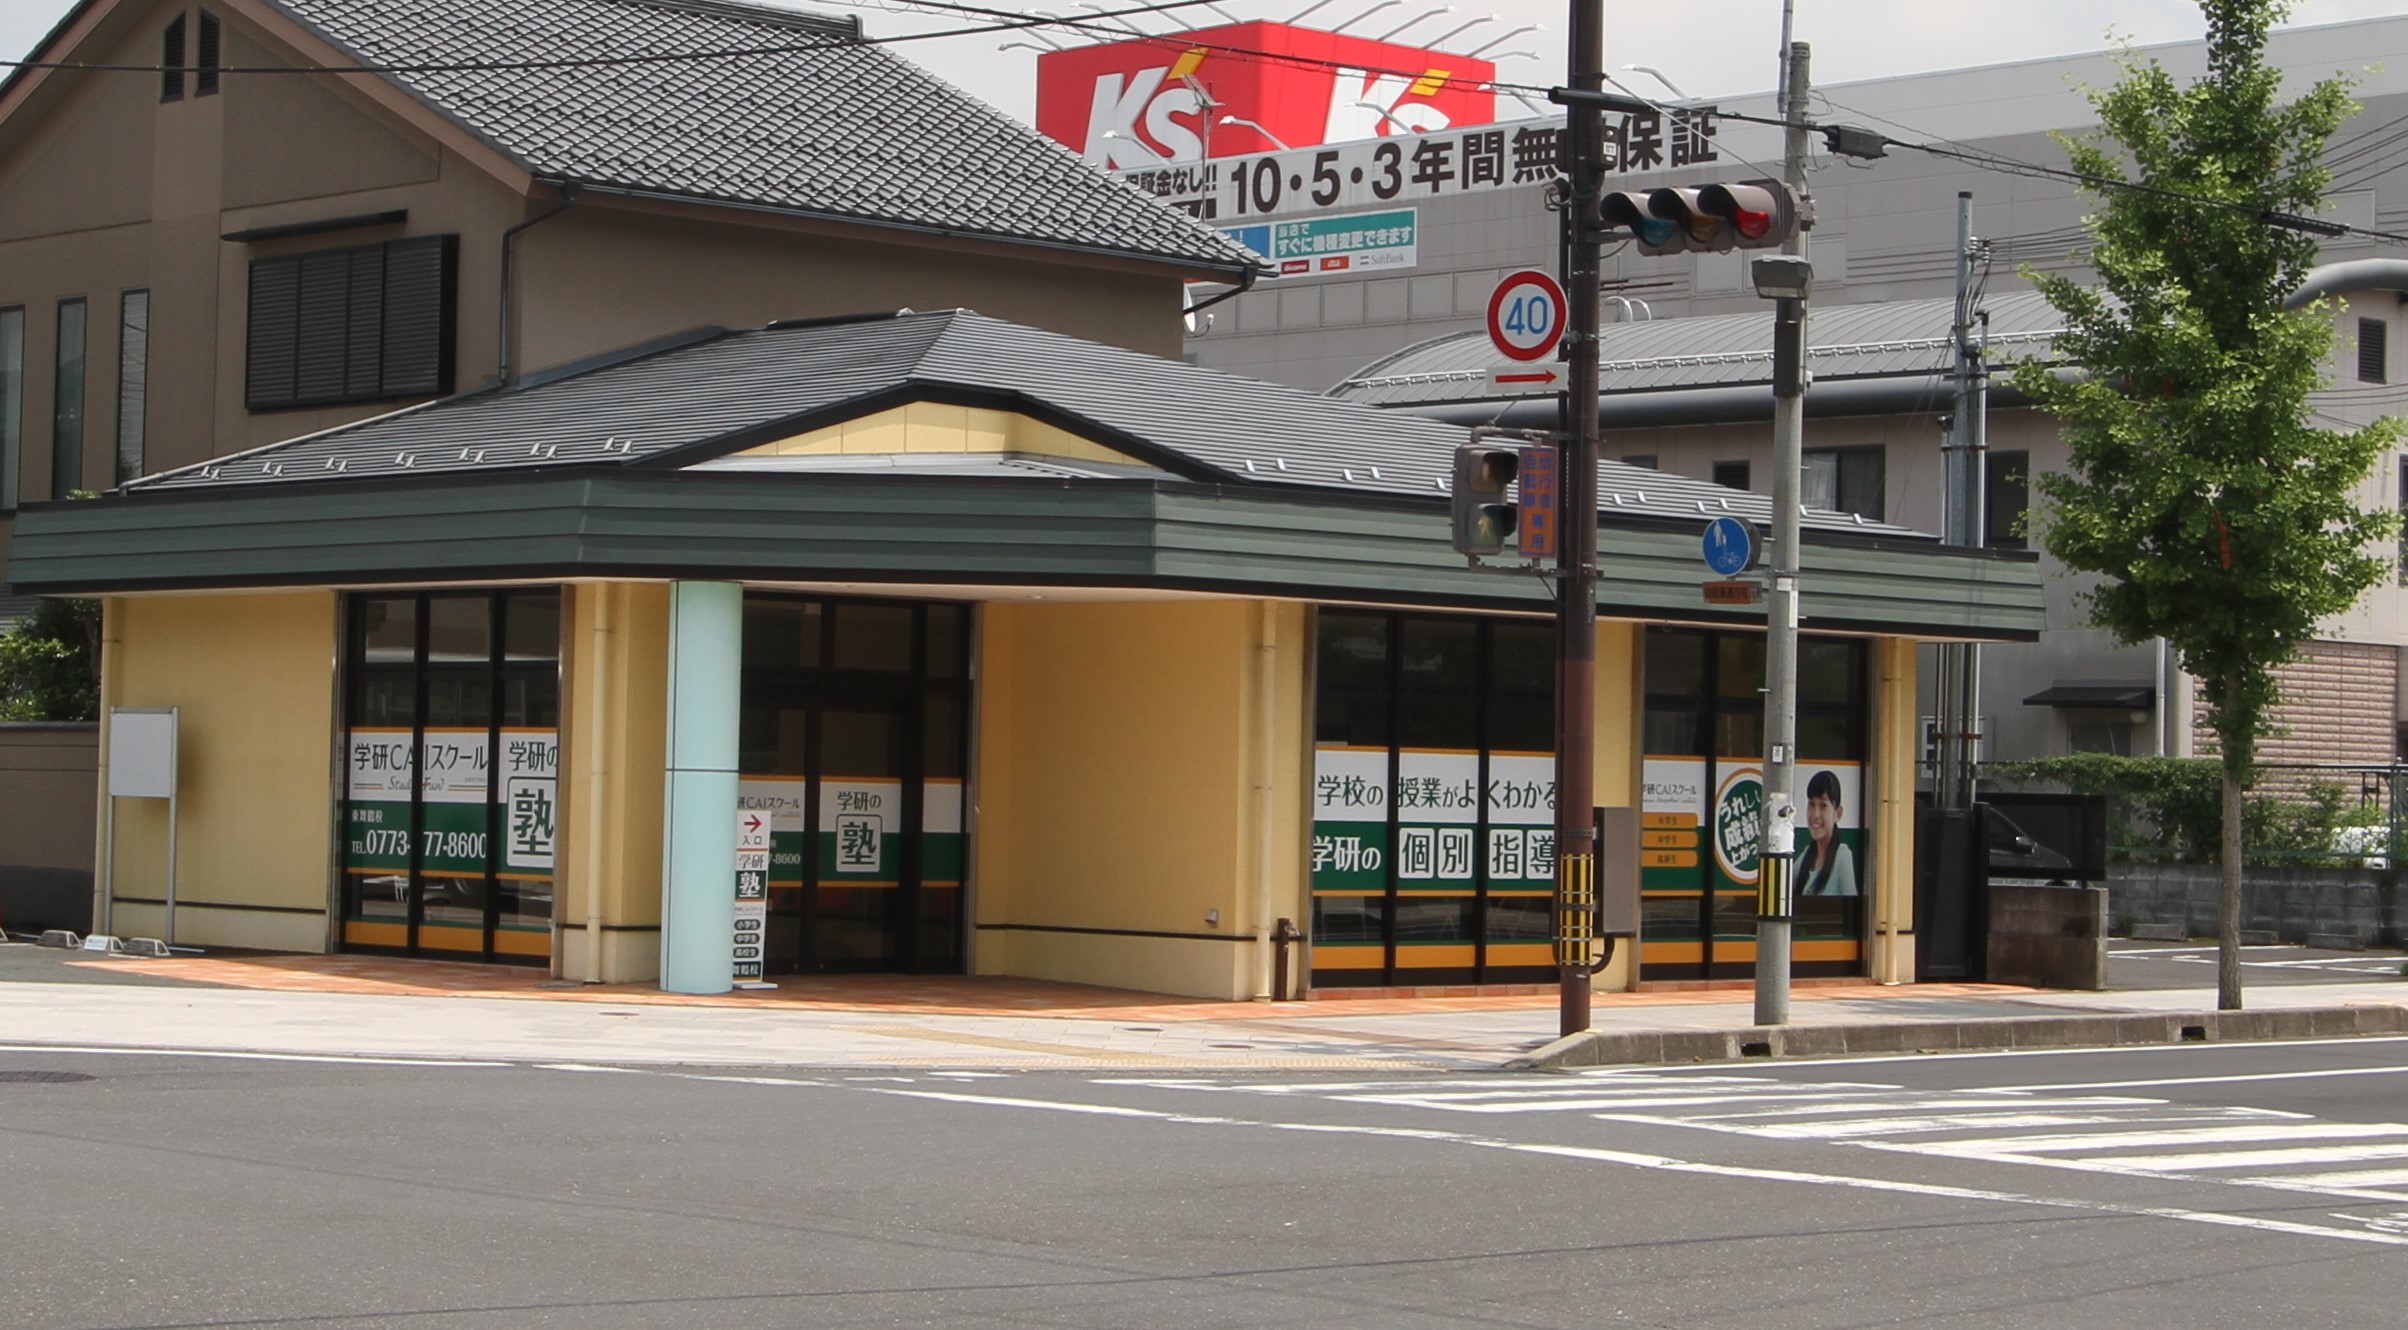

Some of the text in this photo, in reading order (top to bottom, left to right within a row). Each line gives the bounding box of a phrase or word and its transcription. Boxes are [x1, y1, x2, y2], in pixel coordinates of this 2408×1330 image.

[1277, 226, 1412, 256] すぐに機種変更できます
[1278, 223, 1310, 238] 当店で
[1370, 253, 1405, 266] SoftBank
[1505, 295, 1549, 335] 40
[509, 741, 557, 772] 学研の
[838, 791, 881, 811] 学研の
[513, 788, 555, 856] 塾
[743, 836, 762, 845] 入口
[841, 822, 876, 865] 塾
[739, 854, 764, 869] 学研
[739, 872, 760, 897] 塾
